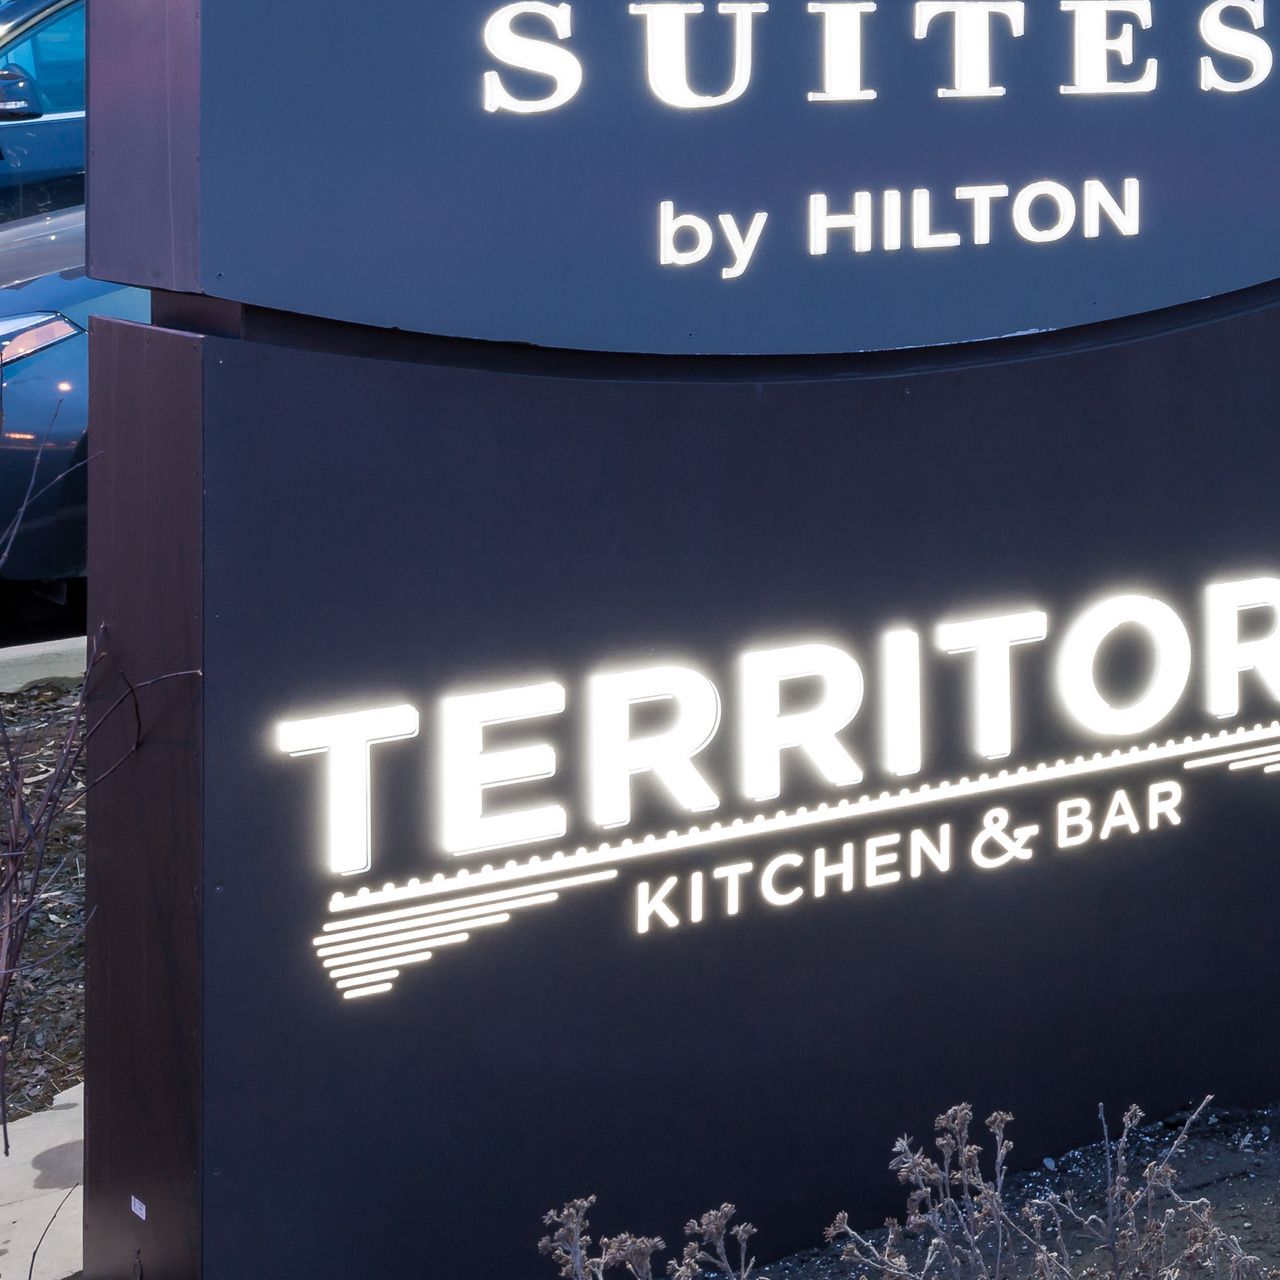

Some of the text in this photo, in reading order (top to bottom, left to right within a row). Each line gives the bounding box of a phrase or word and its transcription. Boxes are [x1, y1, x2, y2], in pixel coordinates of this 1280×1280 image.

[660, 178, 1139, 279] by HILTON
[637, 781, 1182, 933] KITCHEN & BAR
